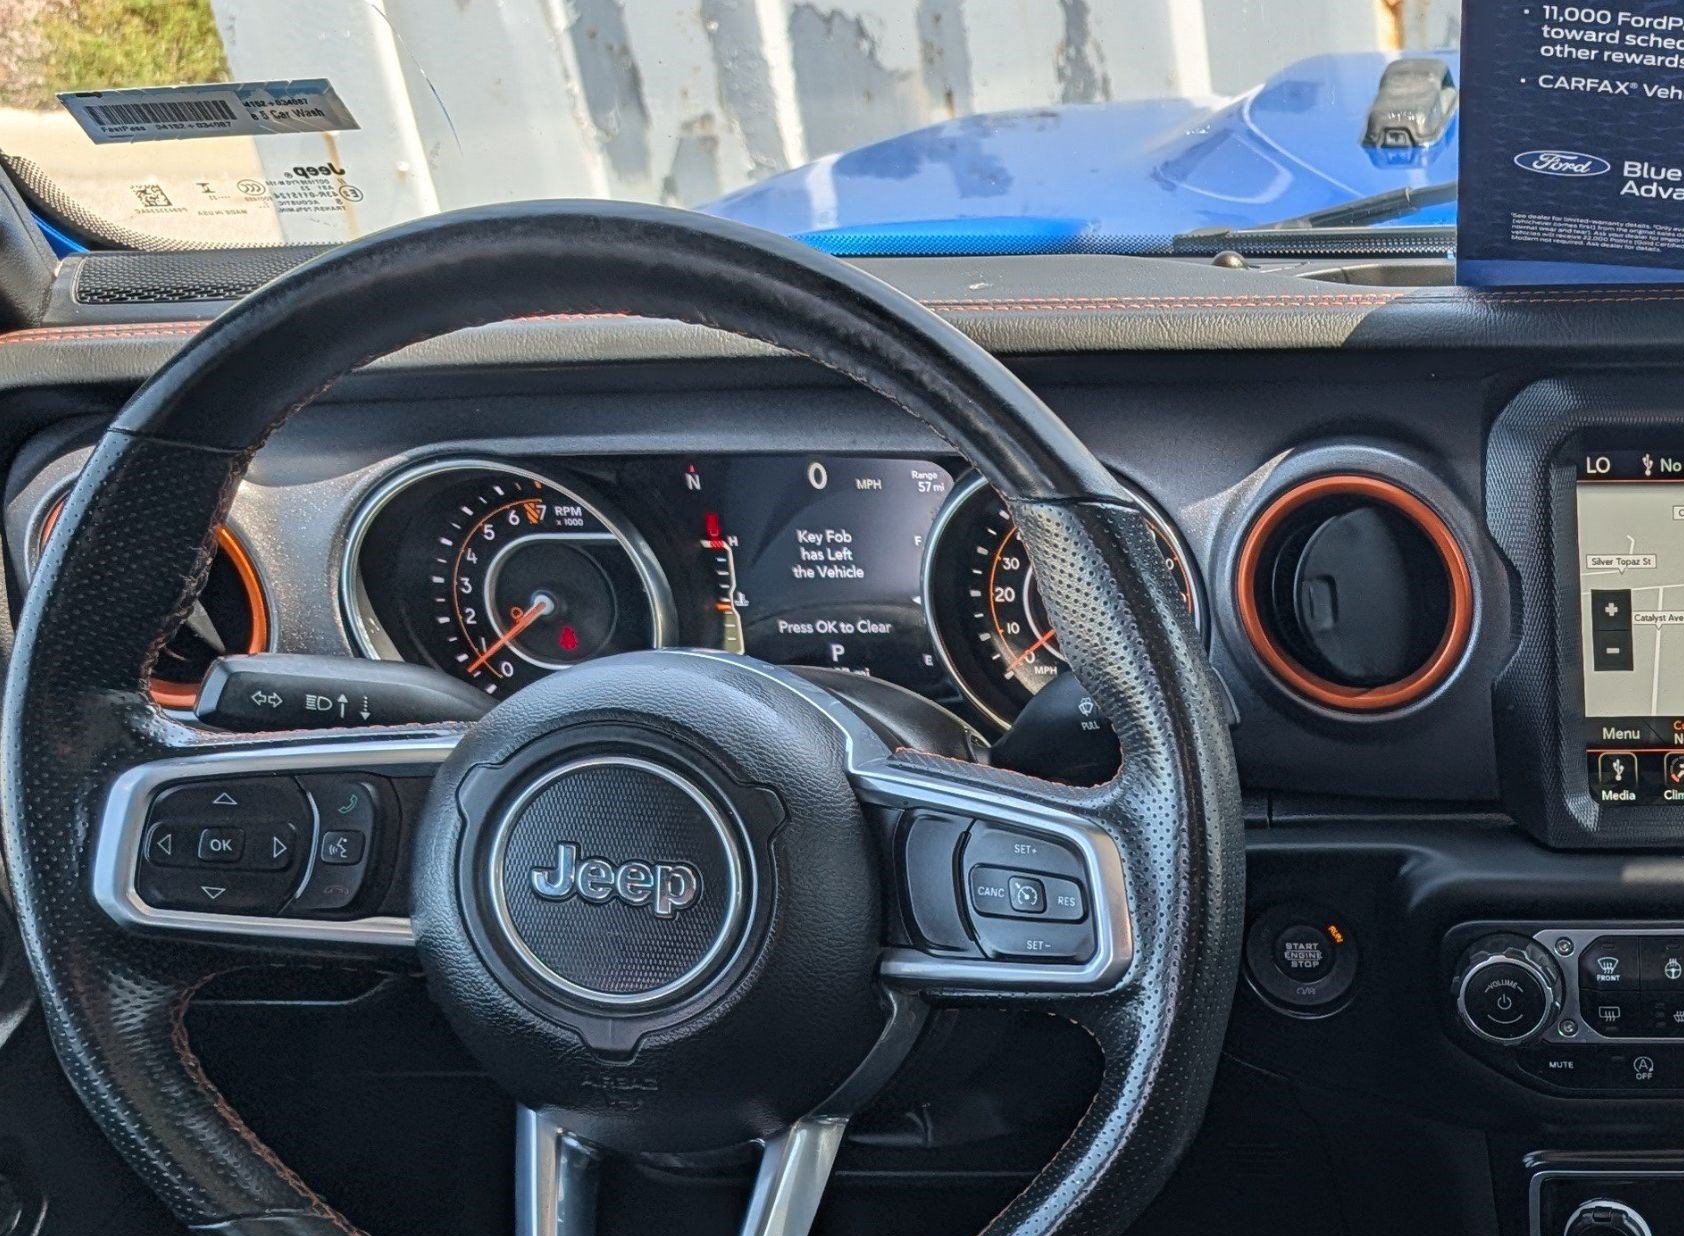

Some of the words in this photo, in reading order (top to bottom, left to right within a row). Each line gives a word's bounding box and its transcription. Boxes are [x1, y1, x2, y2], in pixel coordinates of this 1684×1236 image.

[1542, 5, 1612, 25] 11,000
[1541, 25, 1620, 45] toward
[1539, 44, 1599, 61] other
[271, 108, 292, 120] Car
[293, 106, 326, 118] Wash
[1532, 152, 1592, 175] Ford
[1622, 160, 1683, 182] Blue
[1586, 456, 1611, 474] LO
[1660, 458, 1682, 474] No
[686, 474, 701, 490] N
[808, 461, 828, 490] 0
[911, 470, 938, 482] Range
[855, 479, 882, 490] MPH
[918, 481, 932, 492] 57
[933, 482, 945, 491] mi
[508, 509, 520, 526] 6
[554, 506, 582, 517] RPM
[563, 518, 584, 527] 1000
[483, 525, 495, 541] 5
[796, 530, 824, 545] Key
[826, 529, 852, 543] Fob
[466, 548, 478, 564] 4
[800, 548, 825, 561] has
[826, 548, 853, 561] Left
[1002, 558, 1020, 570] 30
[1591, 557, 1614, 567] Silver
[1616, 558, 1639, 568] Topaz
[1641, 557, 1651, 566] St
[792, 566, 815, 579] the
[818, 566, 865, 579] Vehicle
[460, 577, 472, 594] 3
[995, 587, 1015, 602] 20
[465, 608, 477, 625] 2
[1634, 613, 1666, 624] Catalyst
[1667, 614, 1684, 622] Ave
[778, 620, 813, 634] Press
[815, 621, 838, 633] OK
[841, 621, 855, 633] to
[857, 620, 892, 634] Clear
[1006, 623, 1020, 635] 10
[831, 645, 845, 662] P
[1024, 652, 1035, 665] 0
[501, 661, 514, 677] 0
[1034, 666, 1058, 675] MPH
[1081, 721, 1101, 731] PULL
[1602, 727, 1641, 740] Menu
[1601, 789, 1636, 801] Media
[209, 838, 233, 852] OK
[530, 842, 699, 917] Jeep
[977, 886, 1005, 898] CANC
[1057, 896, 1076, 907] RES
[1285, 942, 1319, 951] START
[1284, 951, 1323, 960] ENGINE
[1291, 960, 1320, 968] STOP
[1596, 974, 1620, 982] FRONT
[1549, 1061, 1574, 1069] MUTE
[1635, 1072, 1653, 1081] OFF
